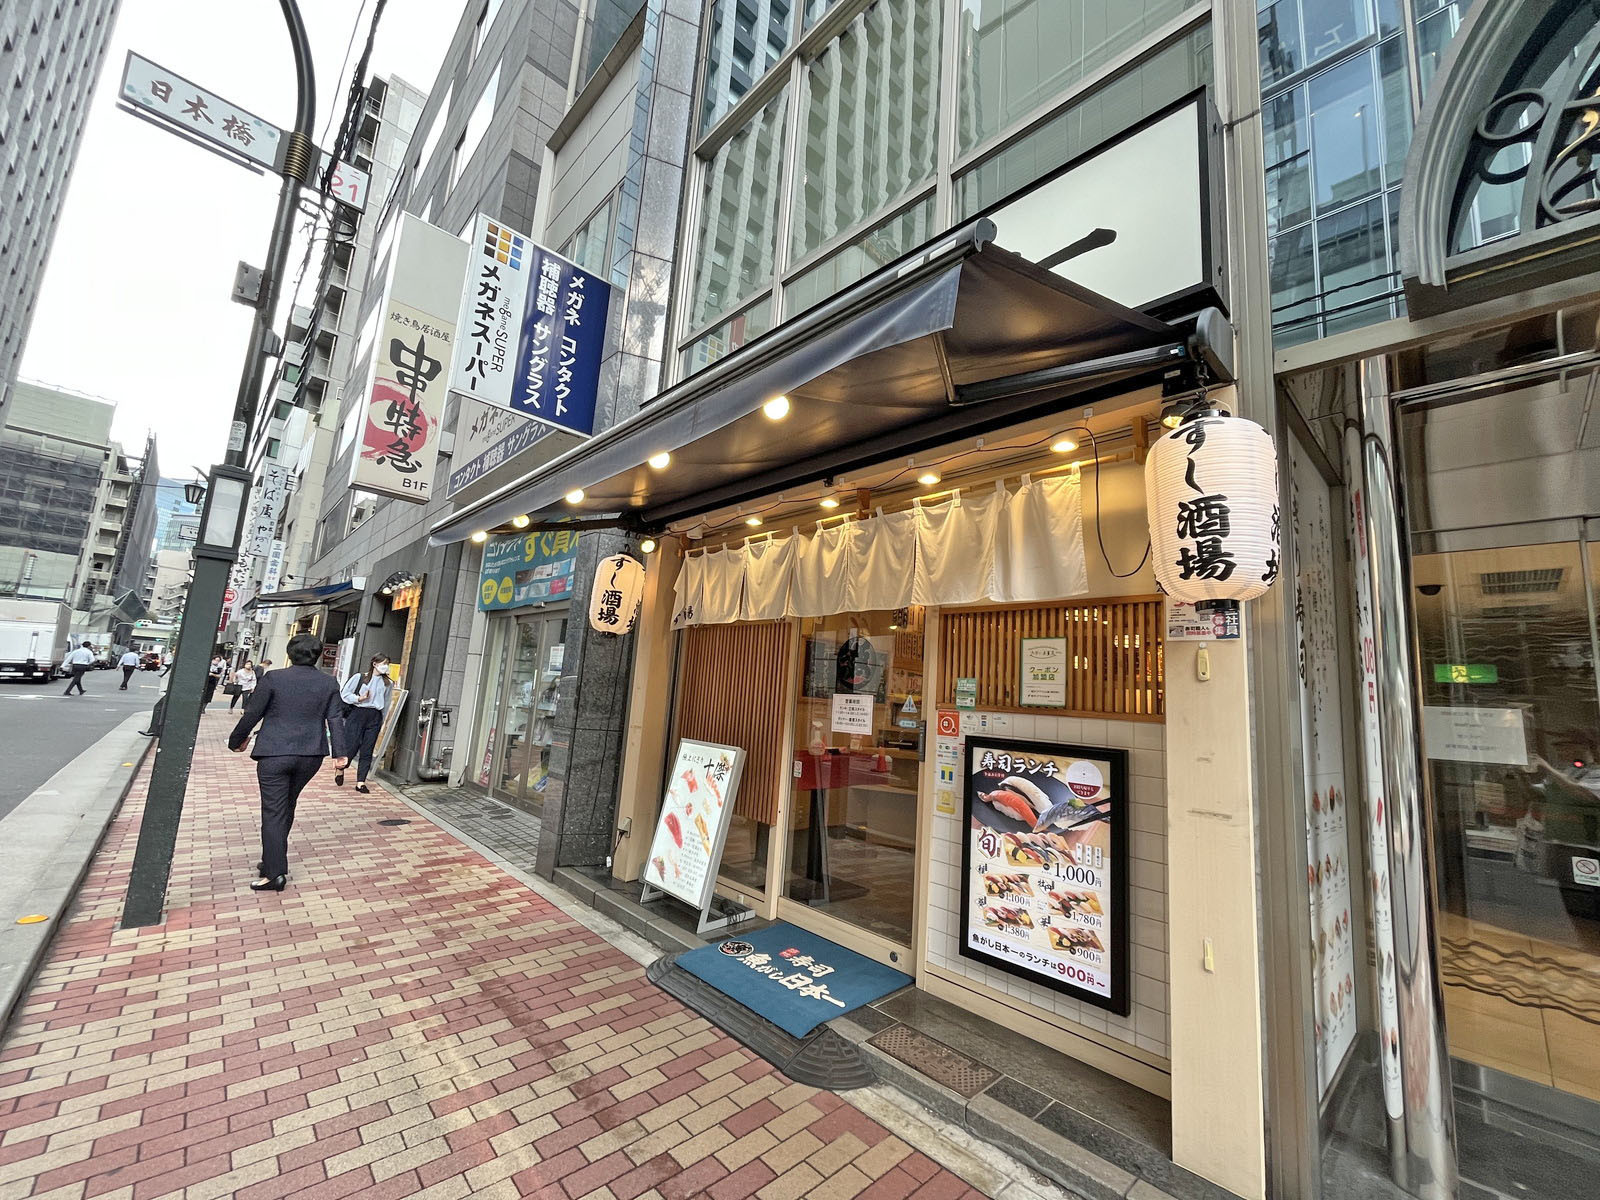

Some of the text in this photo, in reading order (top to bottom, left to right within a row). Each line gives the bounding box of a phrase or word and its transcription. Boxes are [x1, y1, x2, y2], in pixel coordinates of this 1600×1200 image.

[151, 80, 255, 146] 日本橋
[390, 312, 450, 342] 焼き鳥居酒屋
[465, 265, 500, 390] メガネスーパー
[522, 258, 561, 408] 補聴器 サングラス
[554, 274, 585, 416] メガネ コンタクト
[402, 478, 428, 491] B1F
[454, 459, 481, 489] コンタクト
[1170, 419, 1237, 581] すし酒場
[598, 558, 631, 625] すし酒場
[981, 752, 1058, 777] 寿司ランチ
[979, 828, 996, 857] 旬
[1055, 863, 1102, 887] 1,000円
[1073, 912, 1102, 928] 1,780円
[785, 956, 835, 977] 寿司
